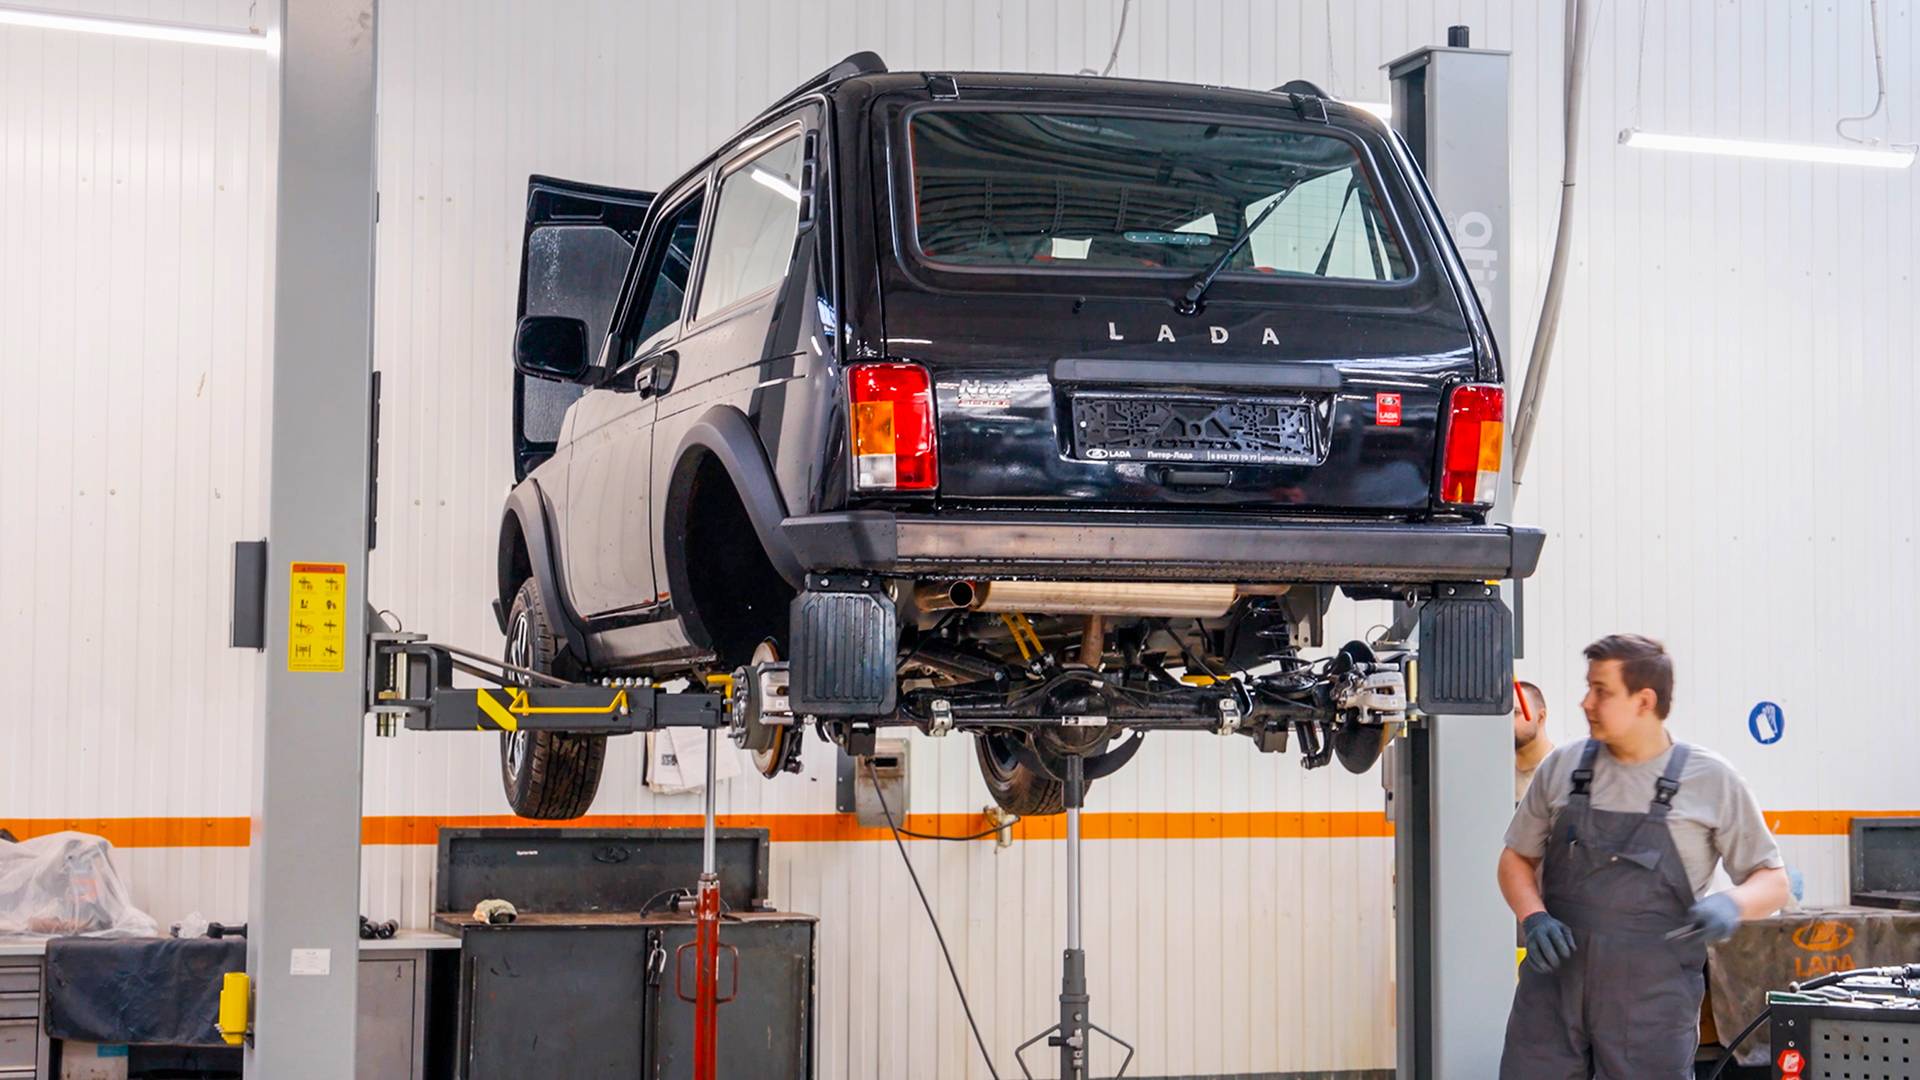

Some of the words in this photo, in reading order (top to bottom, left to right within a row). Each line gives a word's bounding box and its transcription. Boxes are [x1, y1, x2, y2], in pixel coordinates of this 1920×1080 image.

[1108, 322, 1280, 345] LADA
[1379, 411, 1399, 419] LADA
[1109, 450, 1132, 458] LADA
[1147, 451, 1193, 461] Питер-Лада
[1794, 954, 1856, 977] LADA
